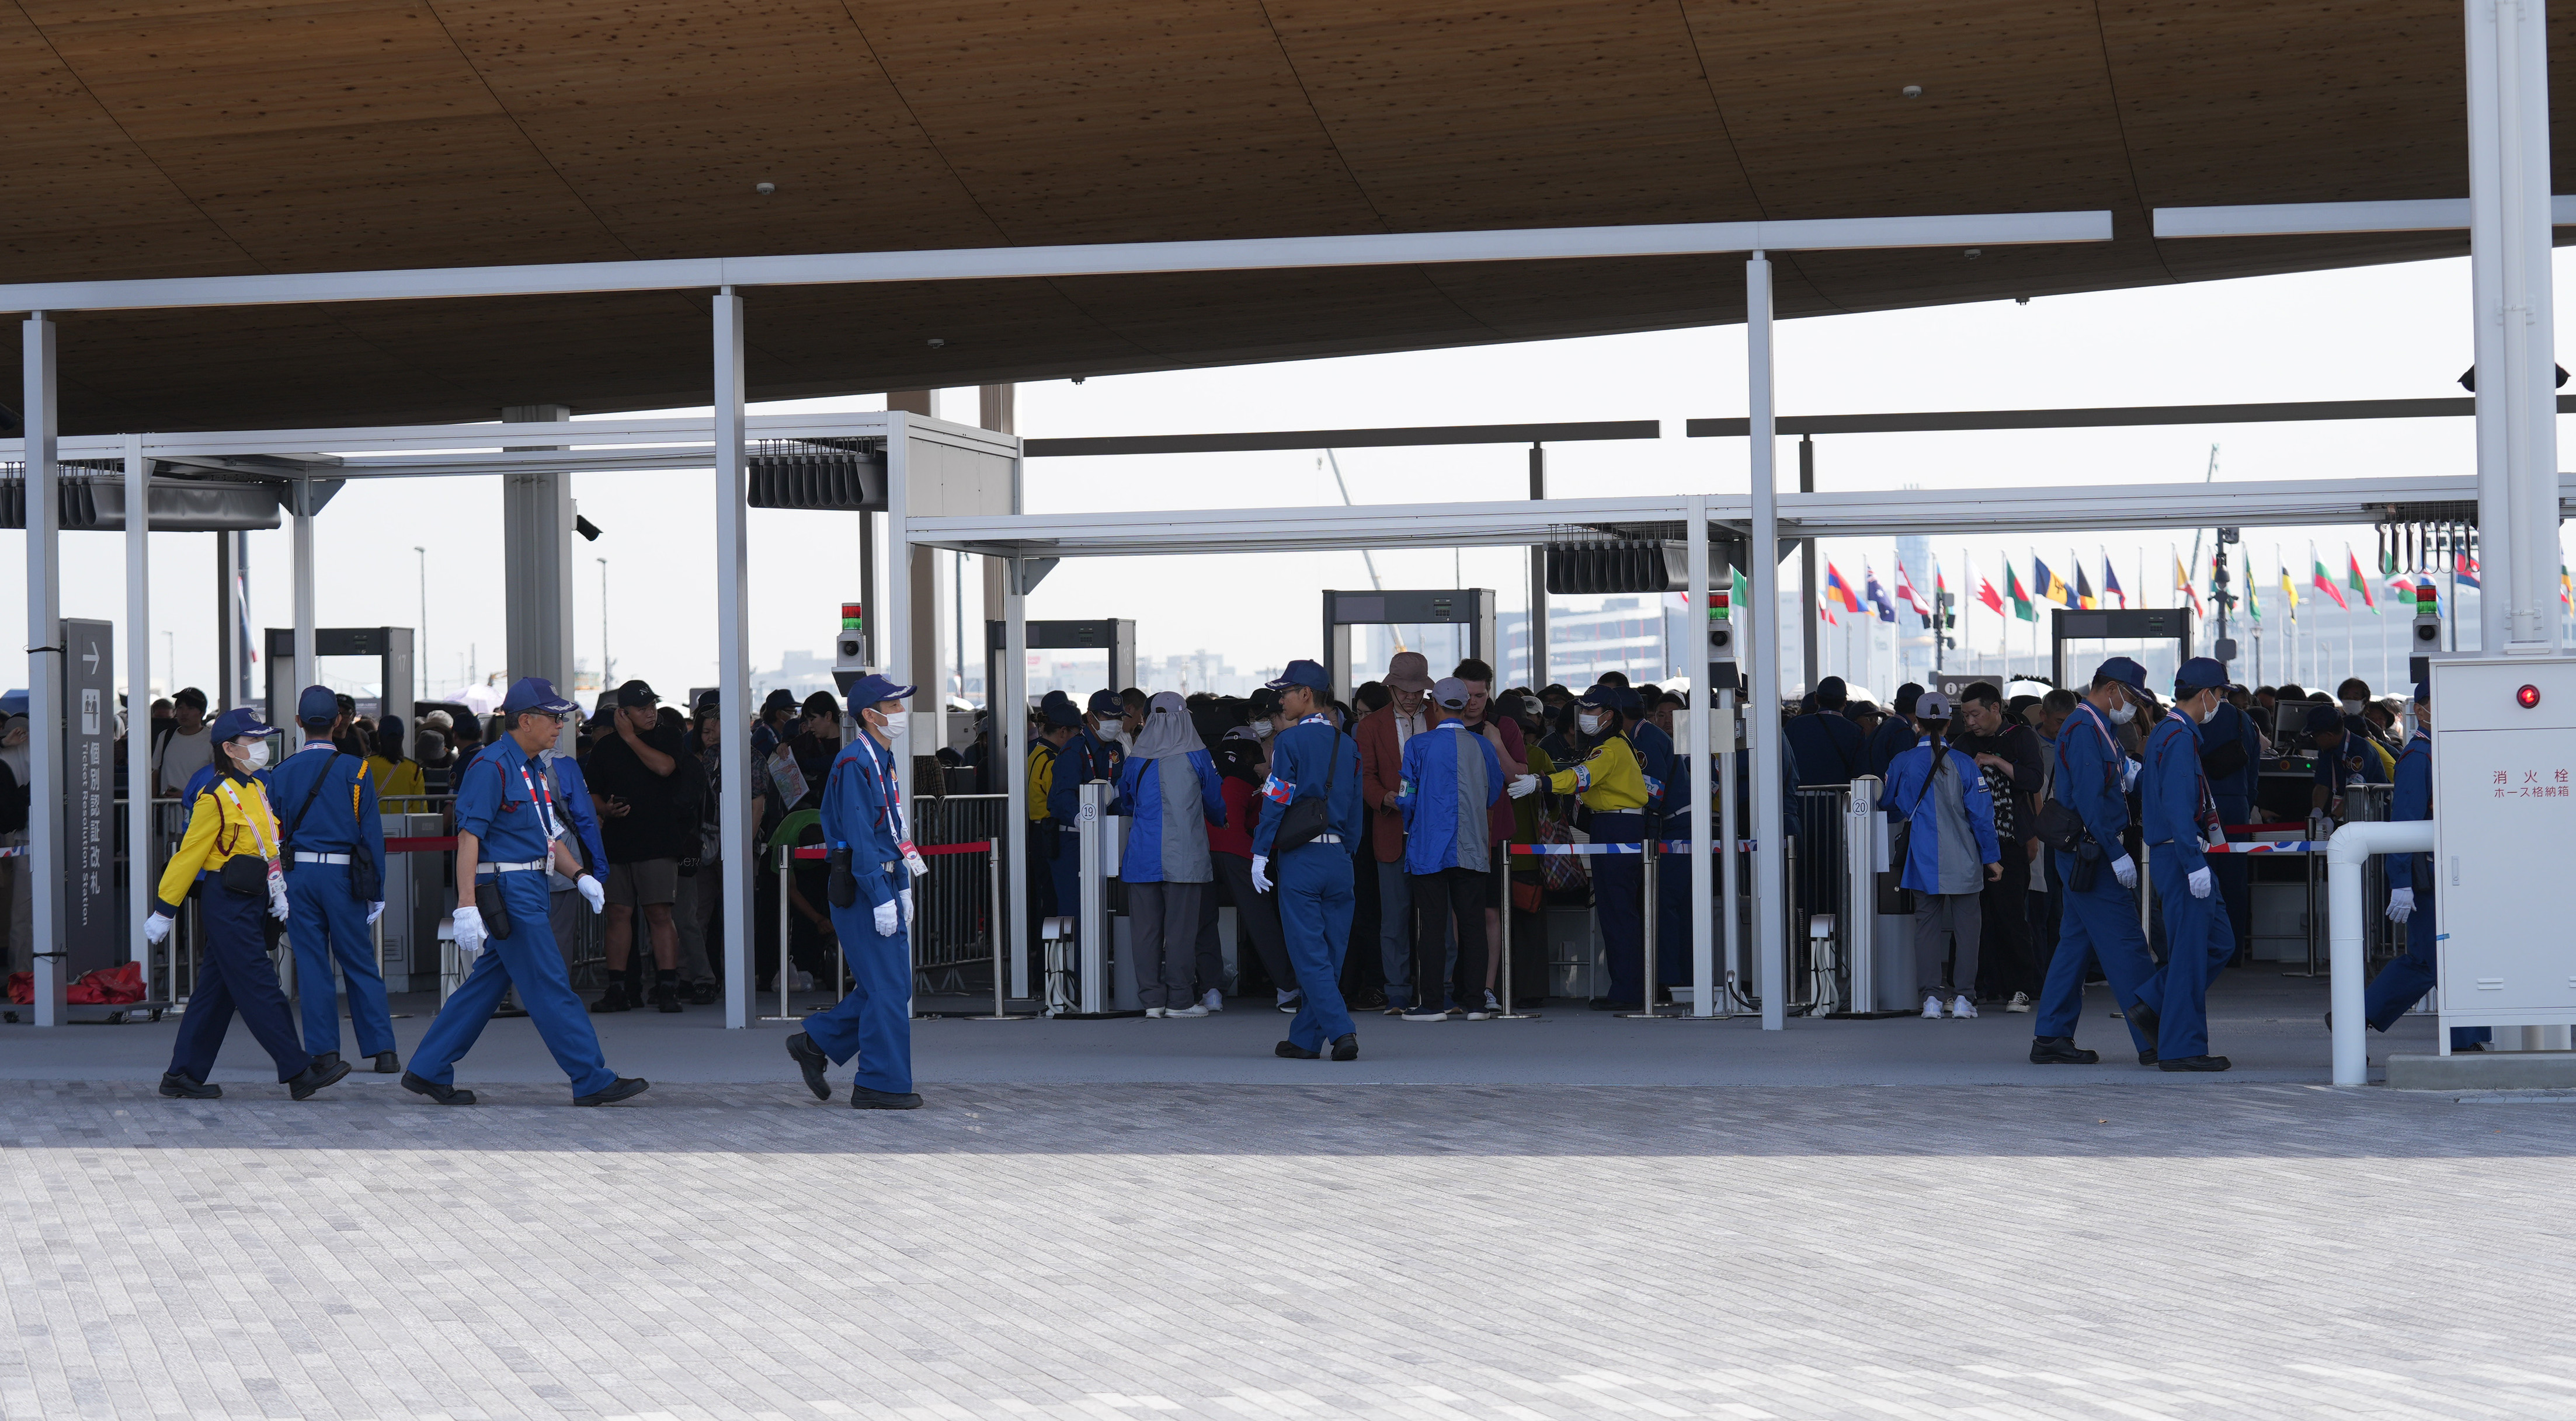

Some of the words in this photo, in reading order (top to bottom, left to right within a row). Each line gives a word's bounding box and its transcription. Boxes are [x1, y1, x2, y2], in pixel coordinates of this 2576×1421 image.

[398, 654, 406, 672] 17
[1124, 646, 1130, 666] 18
[2493, 768, 2569, 785] 消火栓
[2494, 786, 2569, 798] ホース格納箱
[1084, 807, 1093, 817] 19
[1855, 802, 1865, 813] 20
[90, 741, 100, 894] 個別認証改札
